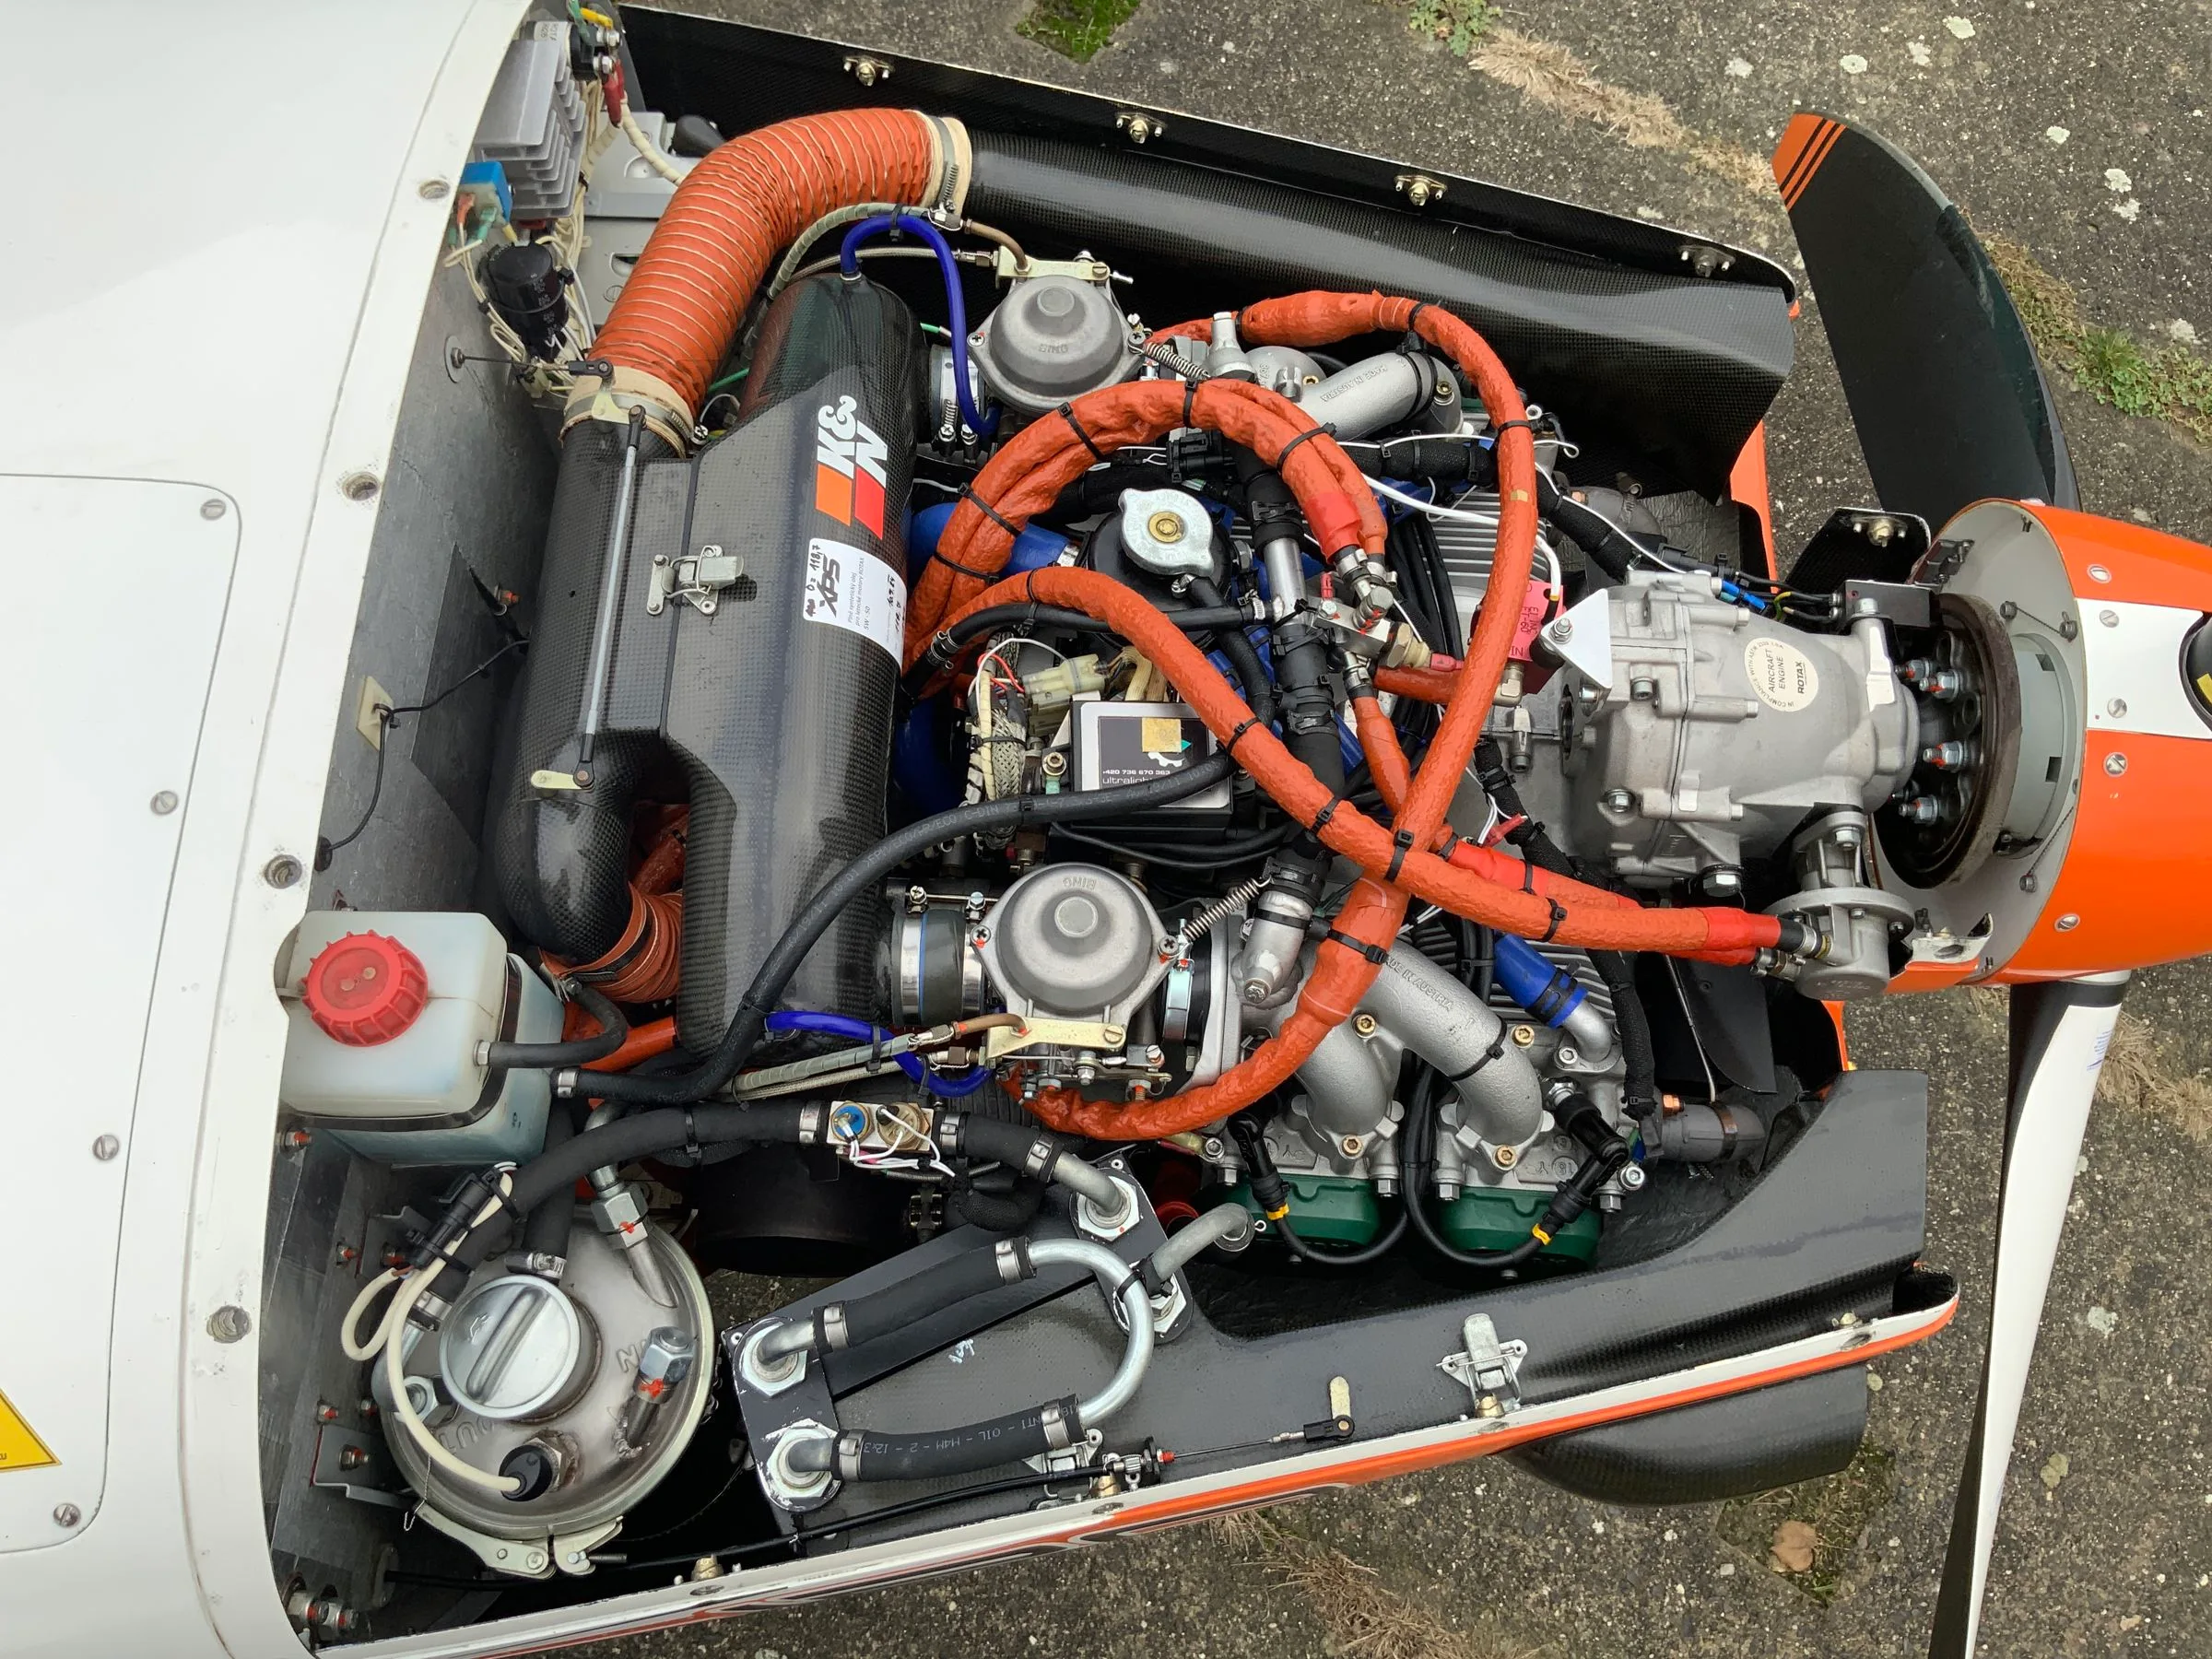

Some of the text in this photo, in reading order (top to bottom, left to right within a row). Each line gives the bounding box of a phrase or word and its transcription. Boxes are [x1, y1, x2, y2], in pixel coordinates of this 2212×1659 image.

[1321, 380, 1357, 403] AUSTRIA
[818, 395, 888, 488] K&N
[817, 553, 840, 618] XPS
[1764, 648, 1775, 693] AIRCRAFT
[1776, 655, 1785, 689] ENGINE
[1794, 661, 1805, 694] ROTAX
[1062, 875, 1097, 890] BING
[1413, 977, 1454, 1012] AUSTRIA
